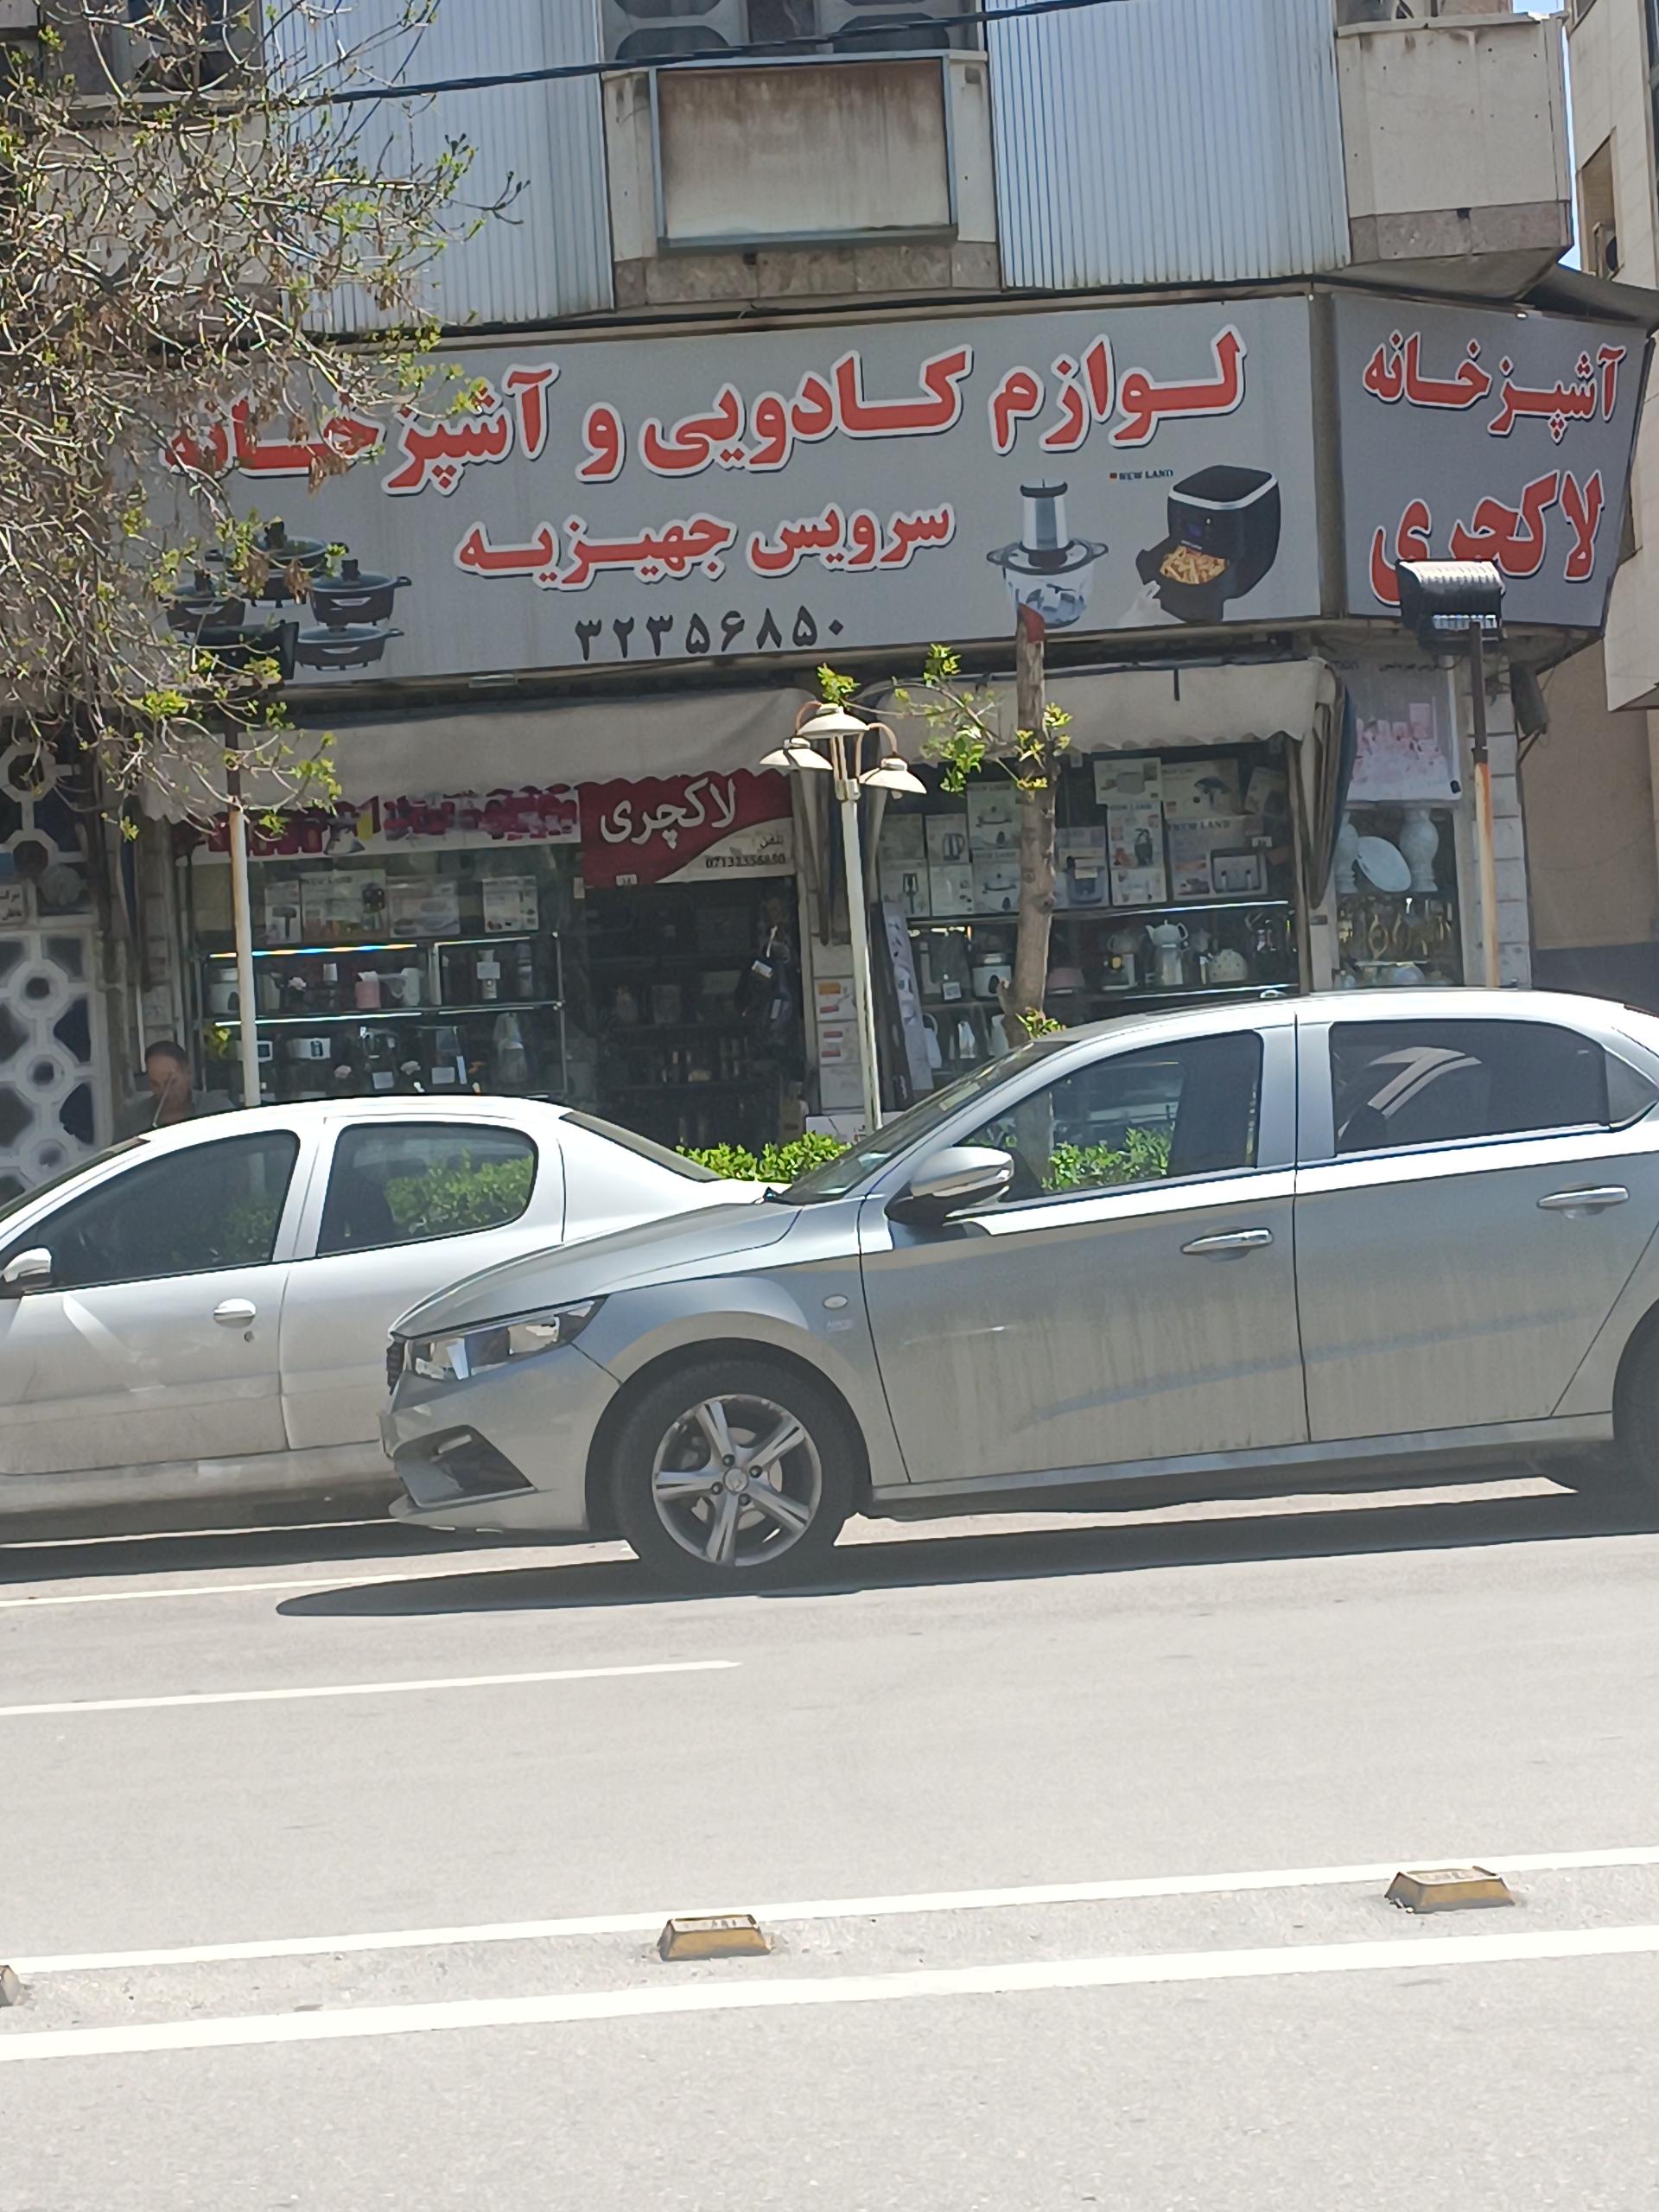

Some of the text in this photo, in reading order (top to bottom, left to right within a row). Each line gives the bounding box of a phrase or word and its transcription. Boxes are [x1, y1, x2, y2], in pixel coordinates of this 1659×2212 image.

[641, 349, 968, 472] کادویی
[991, 330, 1242, 451] لوازم
[1363, 329, 1624, 441] آشپزخانه
[579, 406, 621, 479] و
[1145, 469, 1173, 479] LAND
[457, 508, 953, 588] سرویس جهیزیه
[574, 604, 845, 662] ۳۲۳۵۶۸۵۰
[600, 777, 736, 850] لاکچری
